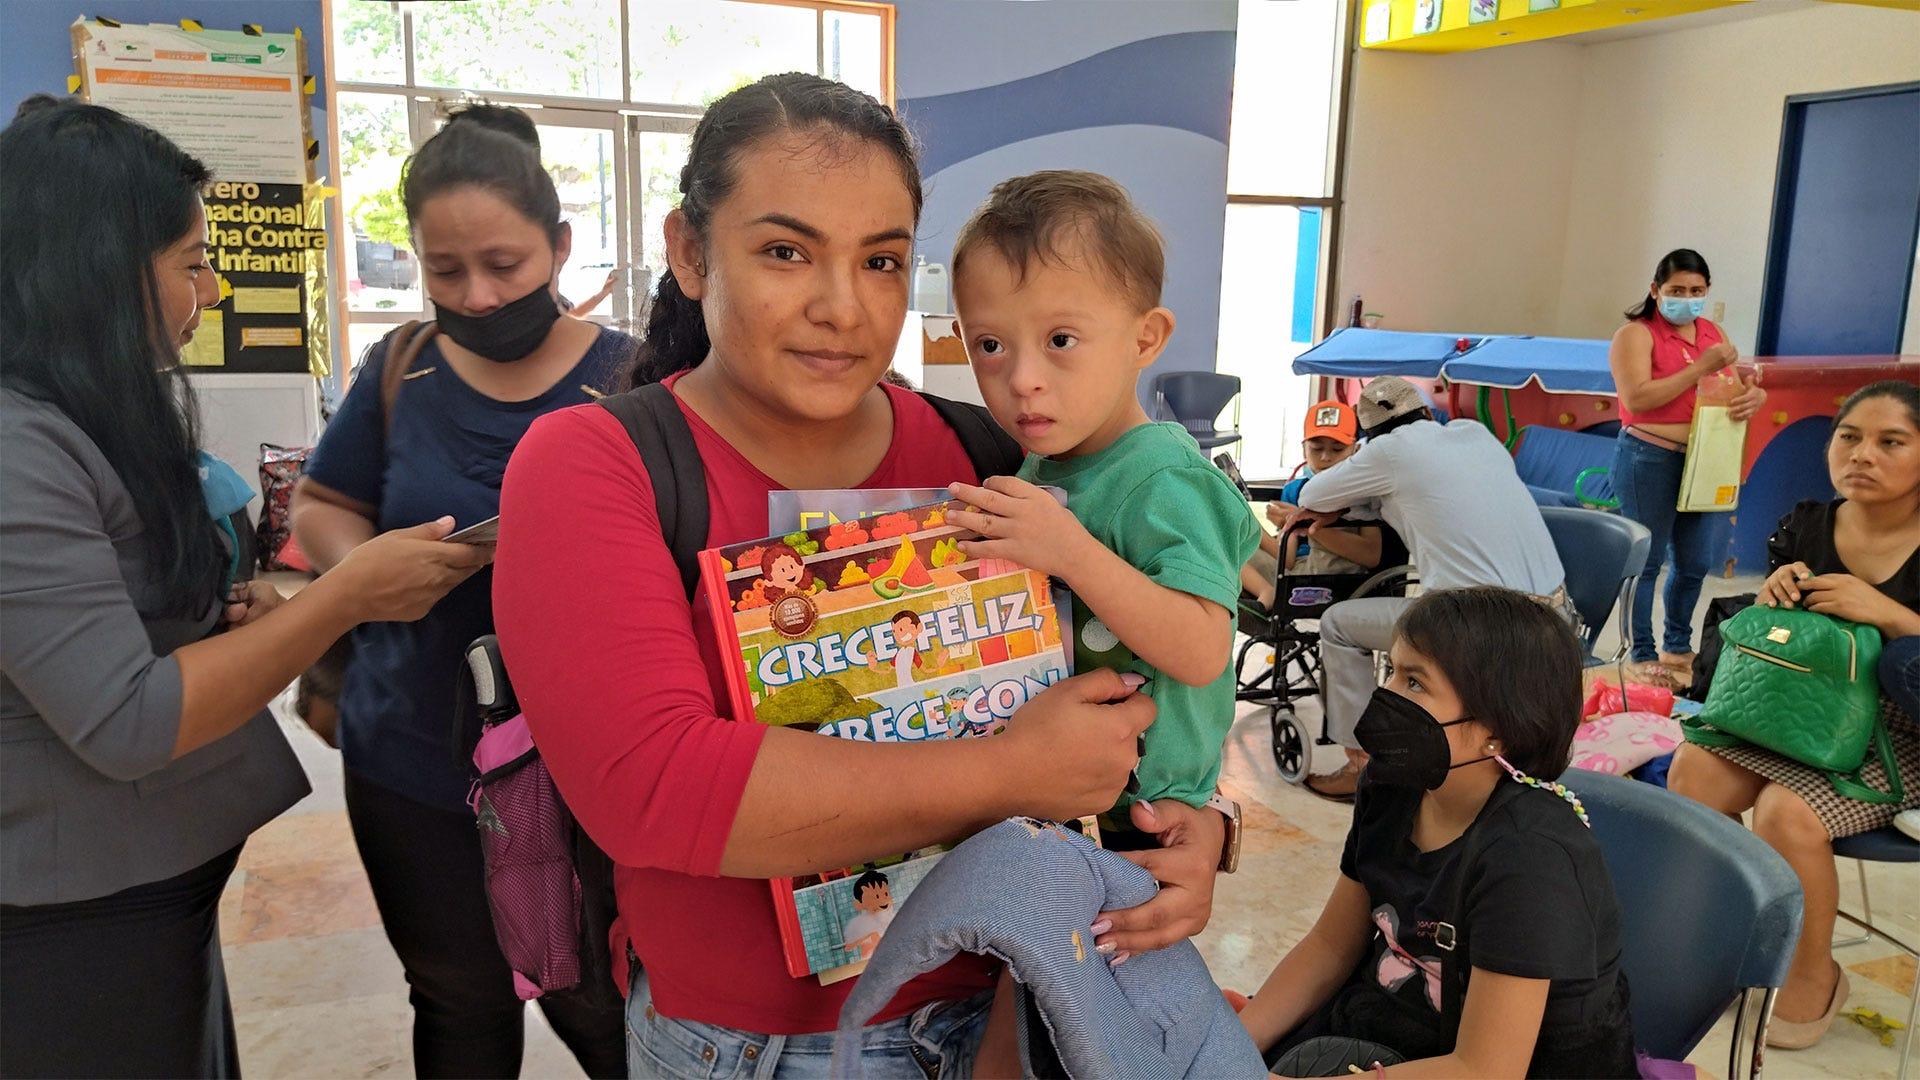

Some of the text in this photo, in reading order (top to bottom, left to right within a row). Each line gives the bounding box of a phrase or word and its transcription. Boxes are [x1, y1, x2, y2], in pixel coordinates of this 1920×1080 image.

[208, 222, 328, 248] ha Contra
[218, 247, 305, 273] Infantil
[758, 591, 1044, 686] CRECE FELIZ,
[816, 695, 950, 742] RECE
